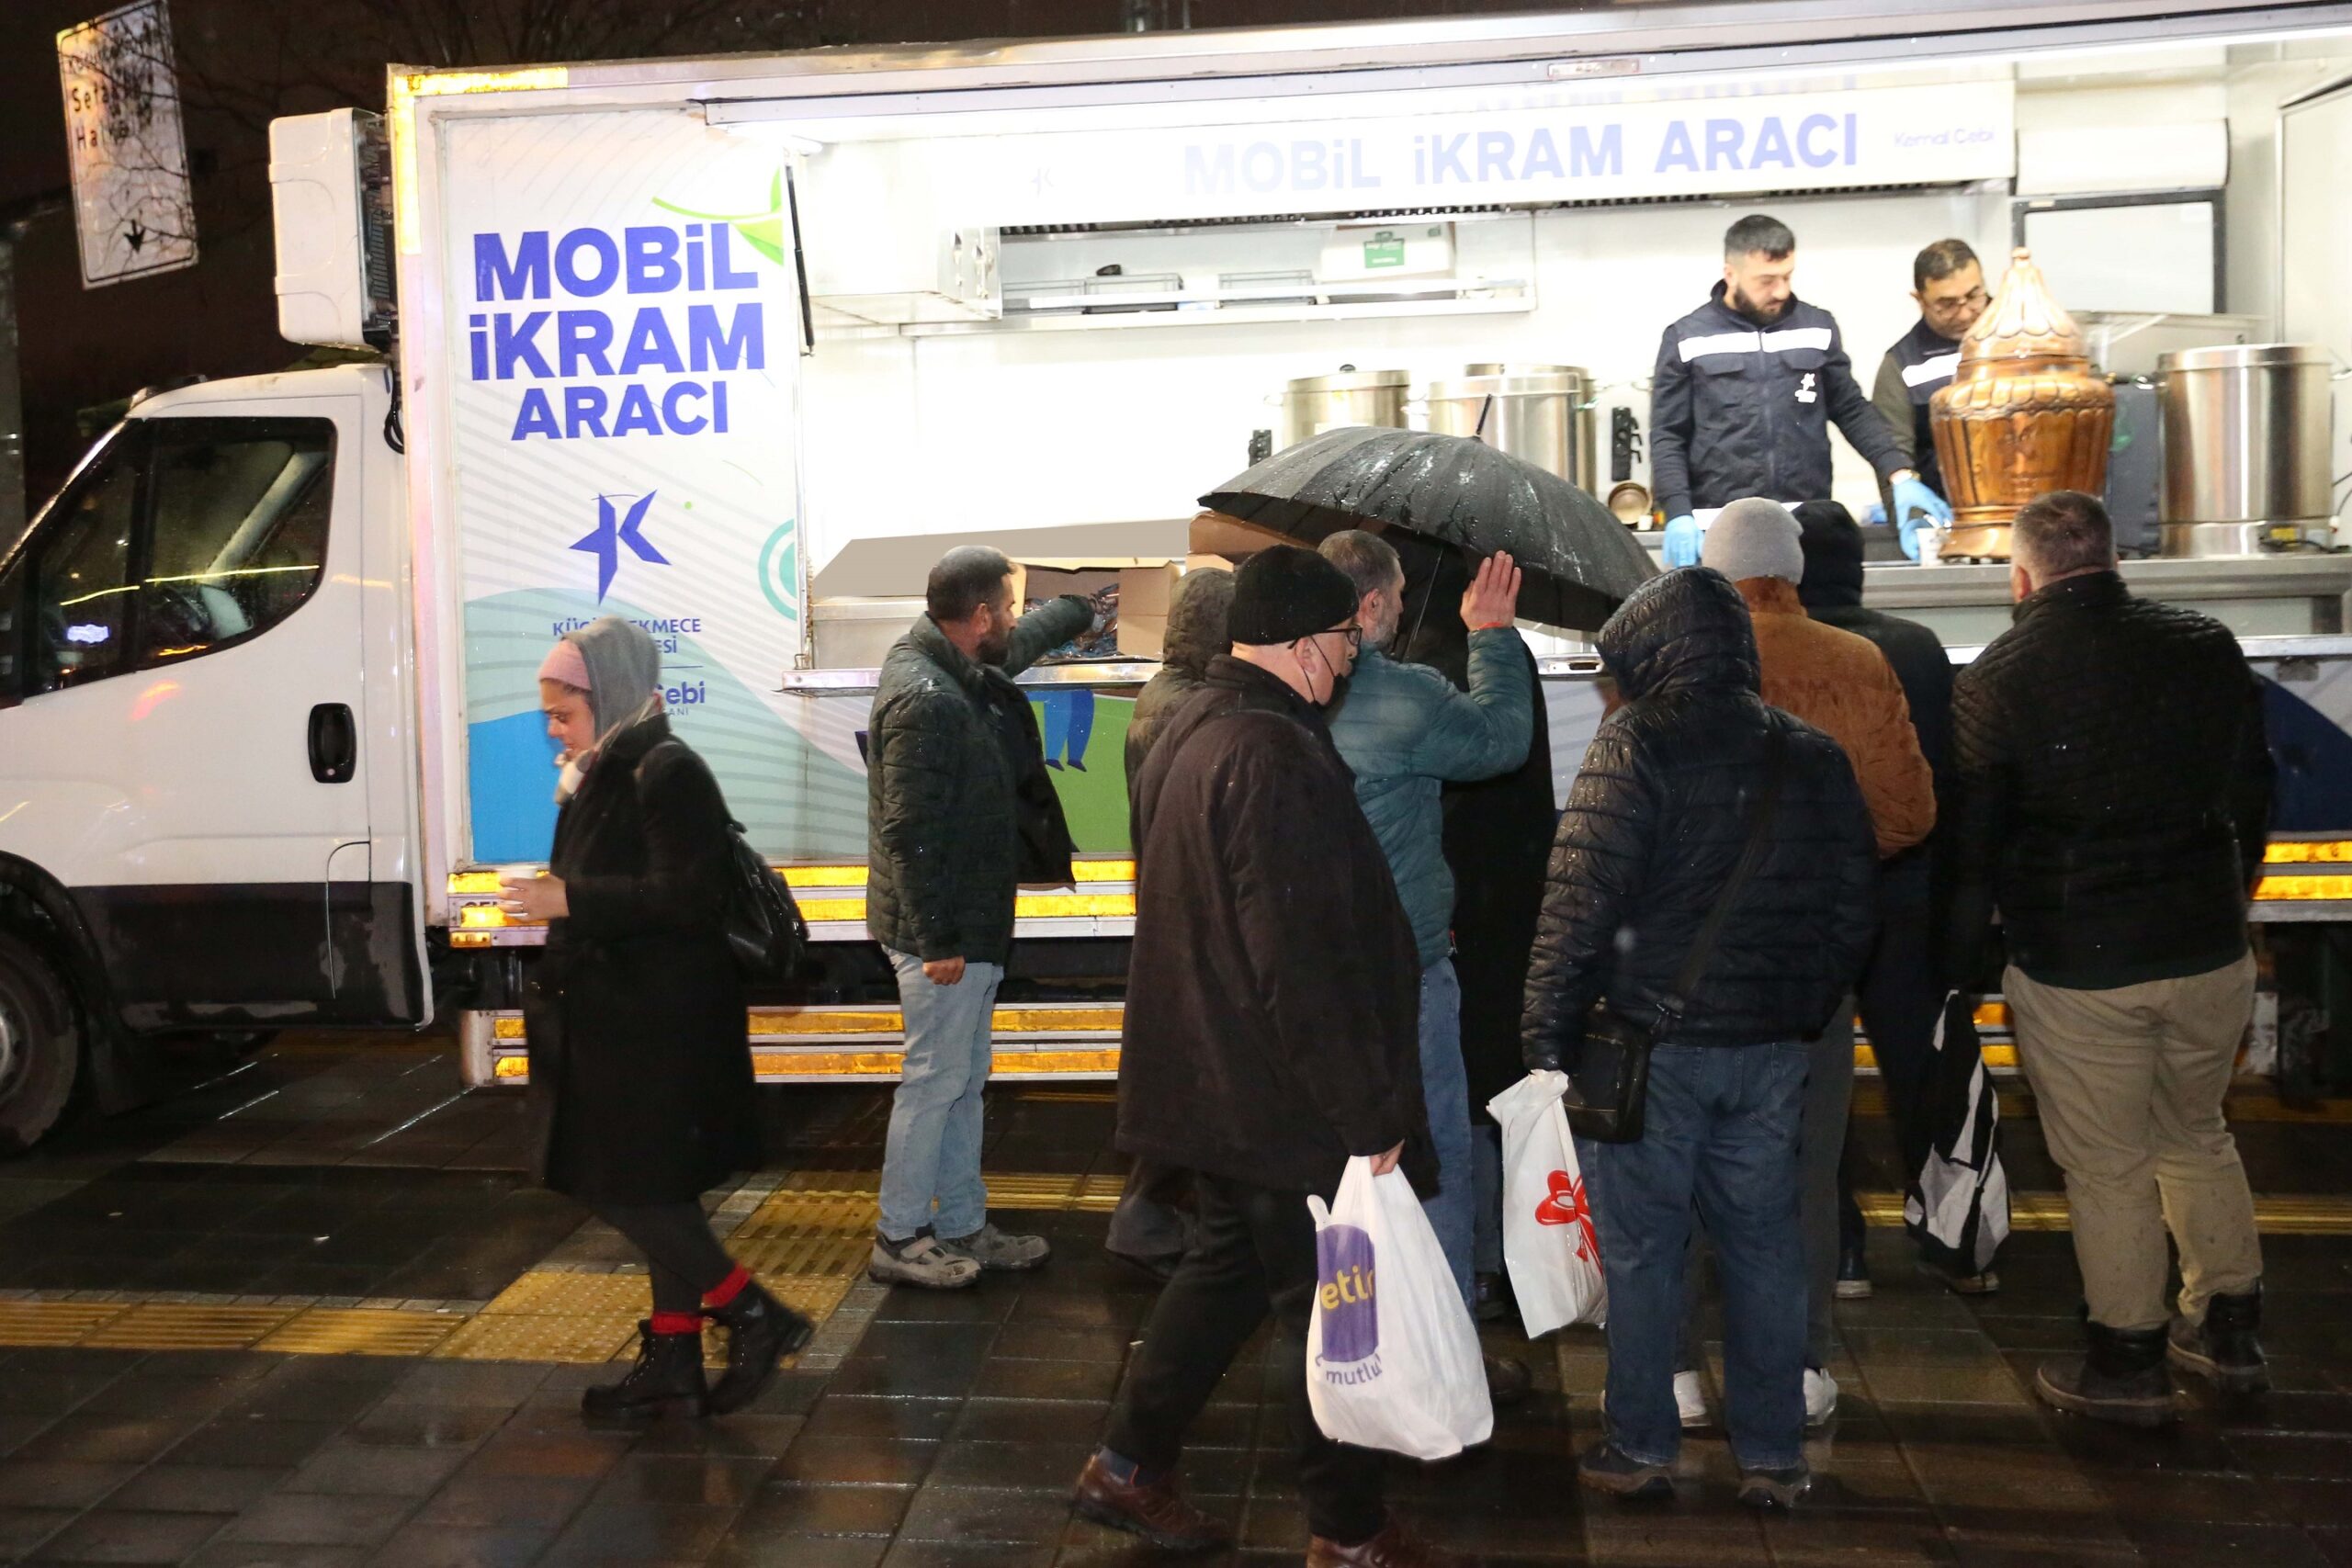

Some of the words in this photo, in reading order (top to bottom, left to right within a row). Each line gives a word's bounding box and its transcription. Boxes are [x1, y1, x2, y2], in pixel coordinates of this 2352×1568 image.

[1654, 112, 1858, 174] ARACI
[511, 381, 729, 441] ARACI
[655, 681, 706, 705] ebi
